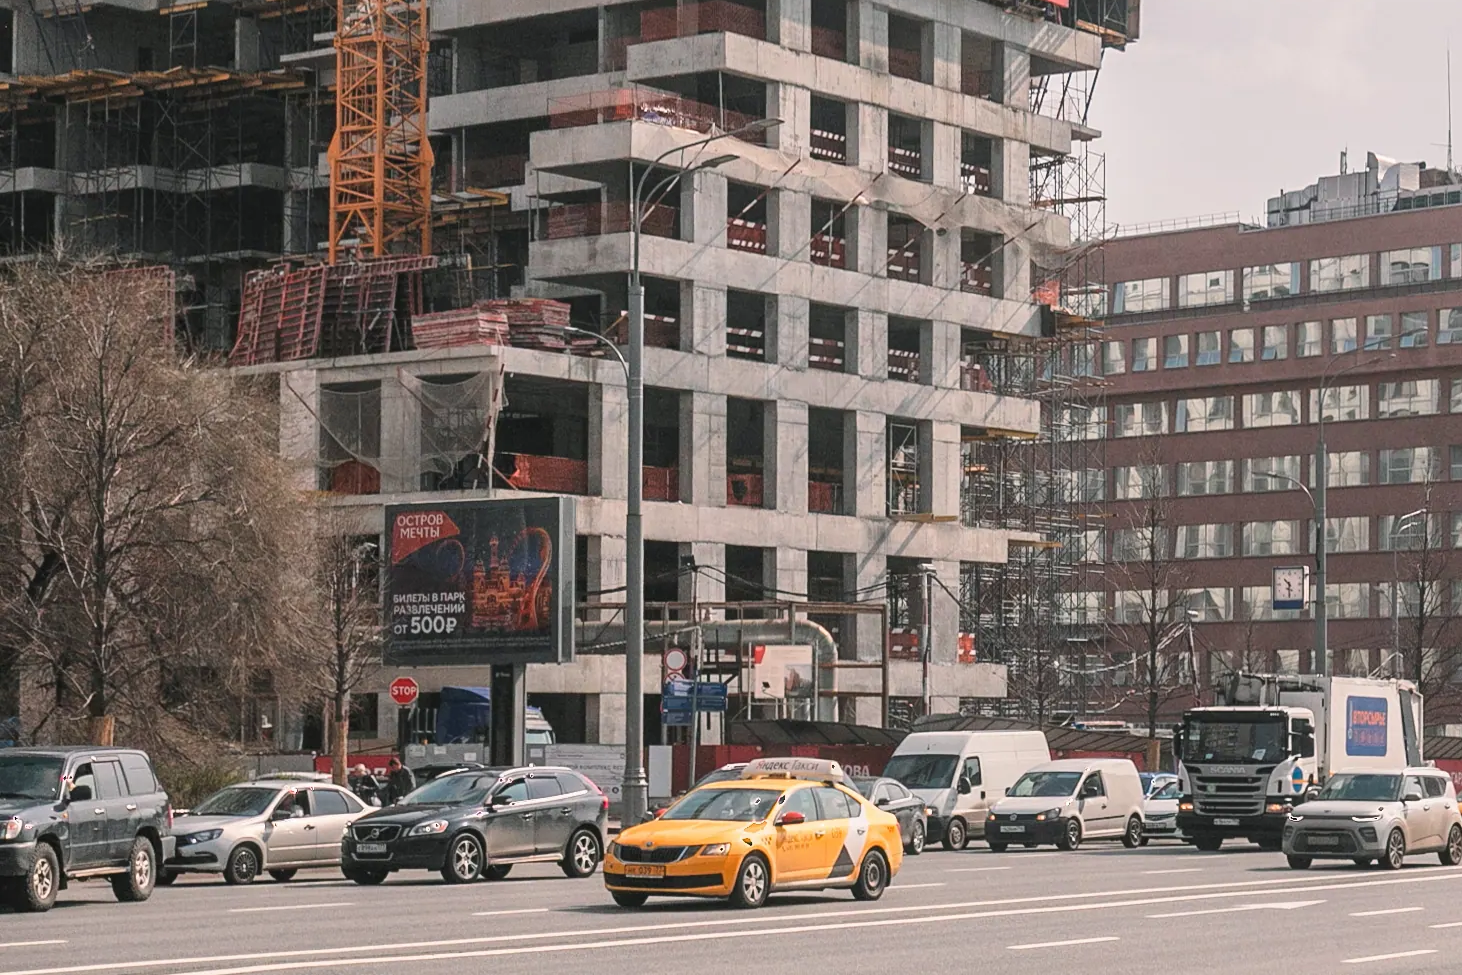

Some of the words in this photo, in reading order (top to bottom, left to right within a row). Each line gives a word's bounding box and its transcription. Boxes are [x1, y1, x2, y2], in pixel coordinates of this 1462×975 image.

[396, 513, 444, 526] ОСТРОВ
[400, 526, 440, 539] МЕЧТЫ
[393, 593, 430, 603] БИЛЕТЫ
[431, 592, 438, 602] В
[440, 592, 466, 601] ПАРК
[393, 601, 466, 615] РАЗВЛЕЧЕНИЙ
[391, 684, 416, 695] STOP
[755, 760, 789, 771] Яндекс
[791, 760, 820, 771] Такси
